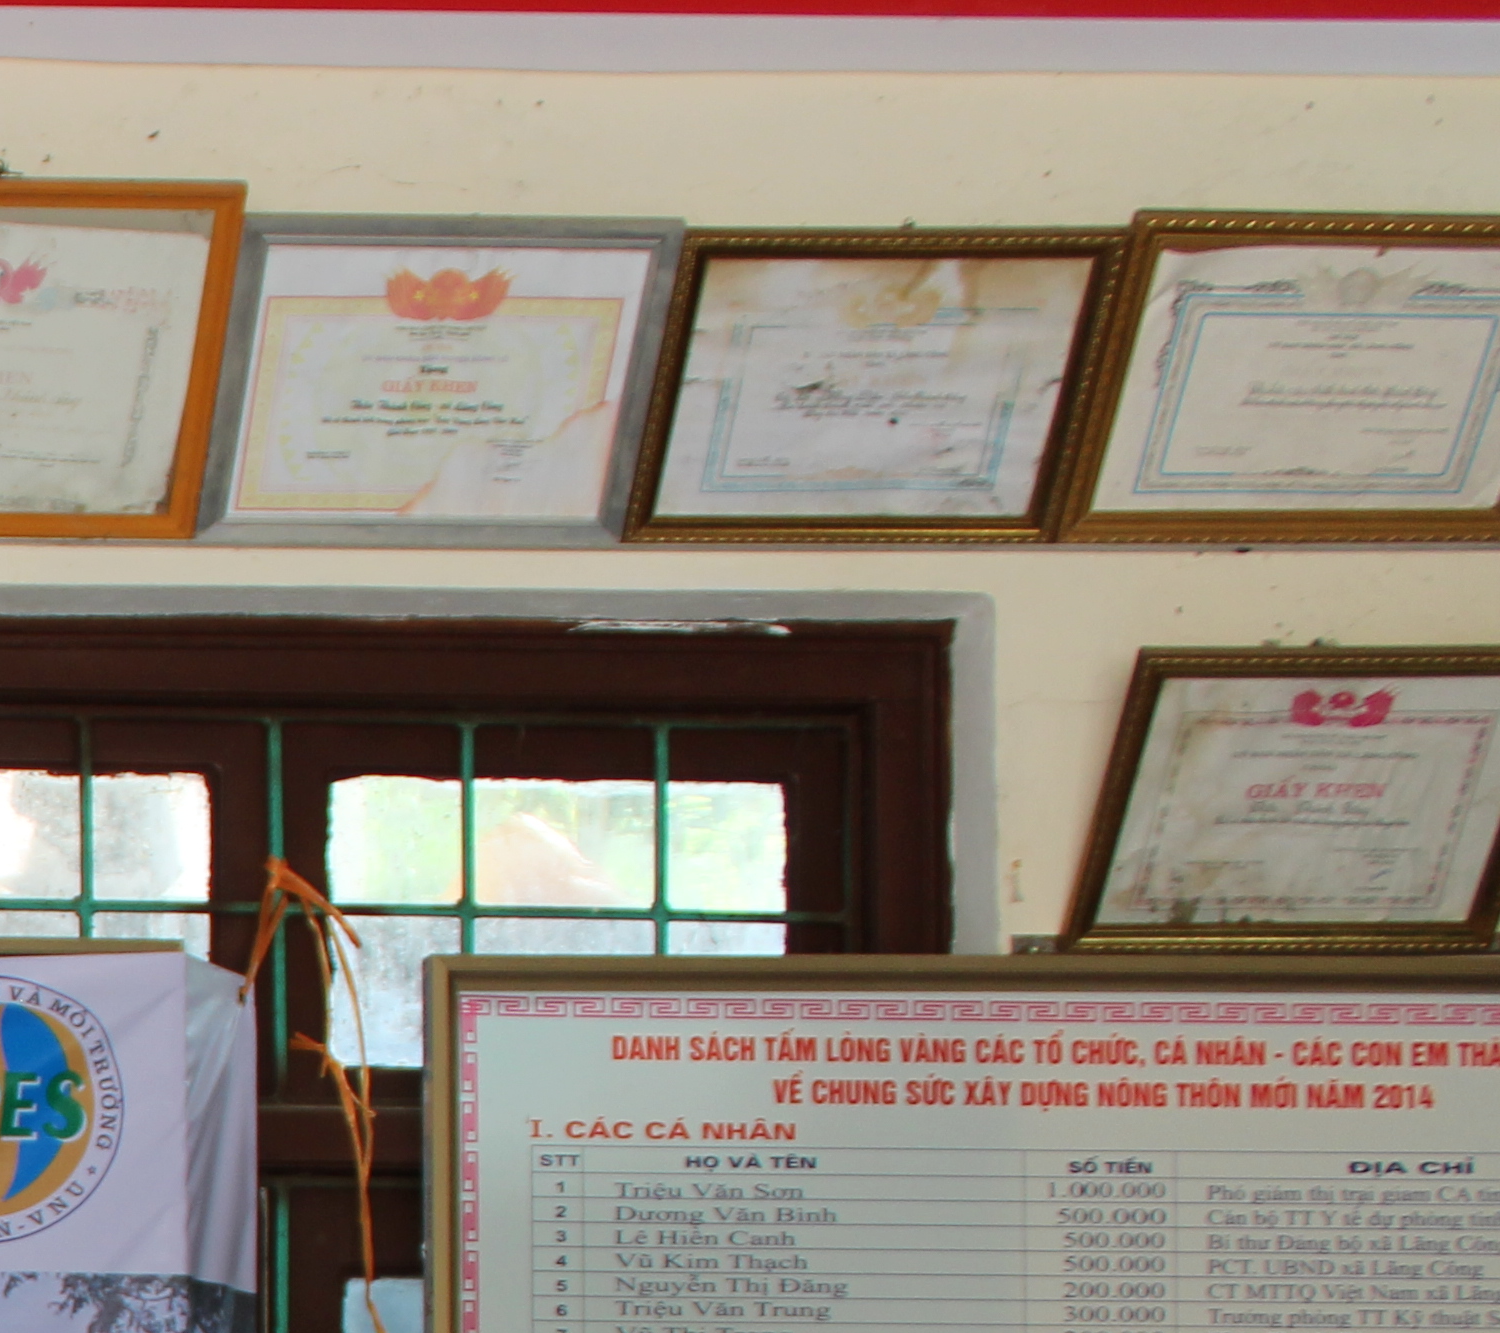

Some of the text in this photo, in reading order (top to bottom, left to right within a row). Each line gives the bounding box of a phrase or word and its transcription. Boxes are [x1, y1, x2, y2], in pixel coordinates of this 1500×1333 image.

[9, 984, 43, 1007] VÀ
[611, 1034, 681, 1061] DANH
[688, 1030, 756, 1062] SÁCH
[763, 1026, 818, 1063] TẤM
[826, 1030, 891, 1064] LÒNG
[900, 1031, 966, 1065] VÀNG
[975, 1032, 1025, 1065] CÁC
[1033, 1029, 1064, 1065] TỔ
[1071, 1033, 1146, 1069] CHỨC,
[1154, 1035, 1190, 1066] CÁ
[1195, 1034, 1267, 1067] NHÂN
[1292, 1035, 1345, 1067] CÁC
[1351, 1039, 1403, 1067] CON
[1411, 1040, 1448, 1067] EM
[772, 1069, 1435, 1112] VỀ CHUNG SỨC XÂY DỰNG NÔNG THÔN MỚI NĂM 2014
[565, 1117, 634, 1140] CÁC
[645, 1117, 691, 1140] CÁ
[701, 1117, 798, 1141] NHÂN
[539, 1153, 581, 1168] STT
[685, 1154, 721, 1172] HỌ
[731, 1152, 762, 1169] VÀ
[770, 1152, 819, 1169] TÊN
[1068, 1155, 1099, 1174] SỐ
[1348, 1159, 1408, 1177] ĐỊA
[615, 1181, 1167, 1200] Triệu Văn Sơn 1.000.000
[615, 1205, 1167, 1225] Dương Văn 500.000
[616, 1252, 1167, 1274] Vũ Kim Thạch 500.000
